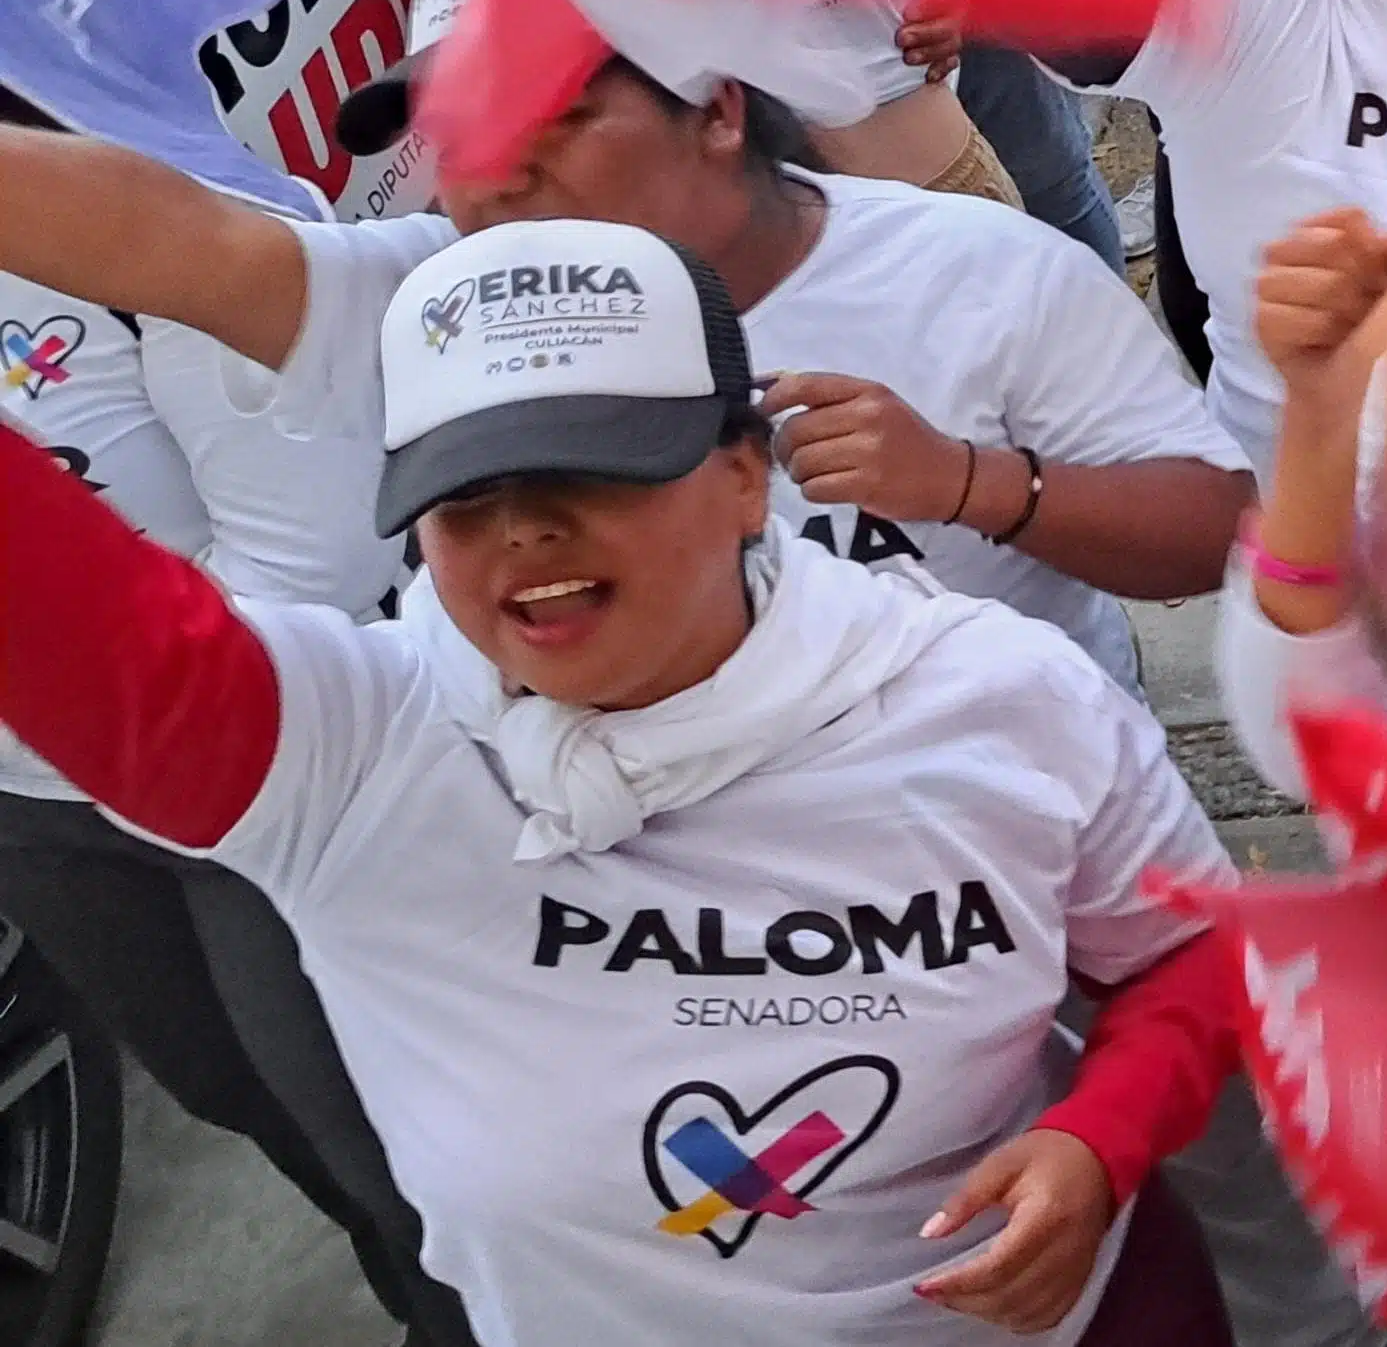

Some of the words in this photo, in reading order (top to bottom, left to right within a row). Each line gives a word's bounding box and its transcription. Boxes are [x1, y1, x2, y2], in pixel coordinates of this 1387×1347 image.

[479, 264, 643, 304] ERIKA
[484, 326, 563, 344] Presidente
[567, 323, 640, 339] Municipal
[533, 880, 1016, 977] PALOMA
[673, 994, 907, 1028] SENADORA
